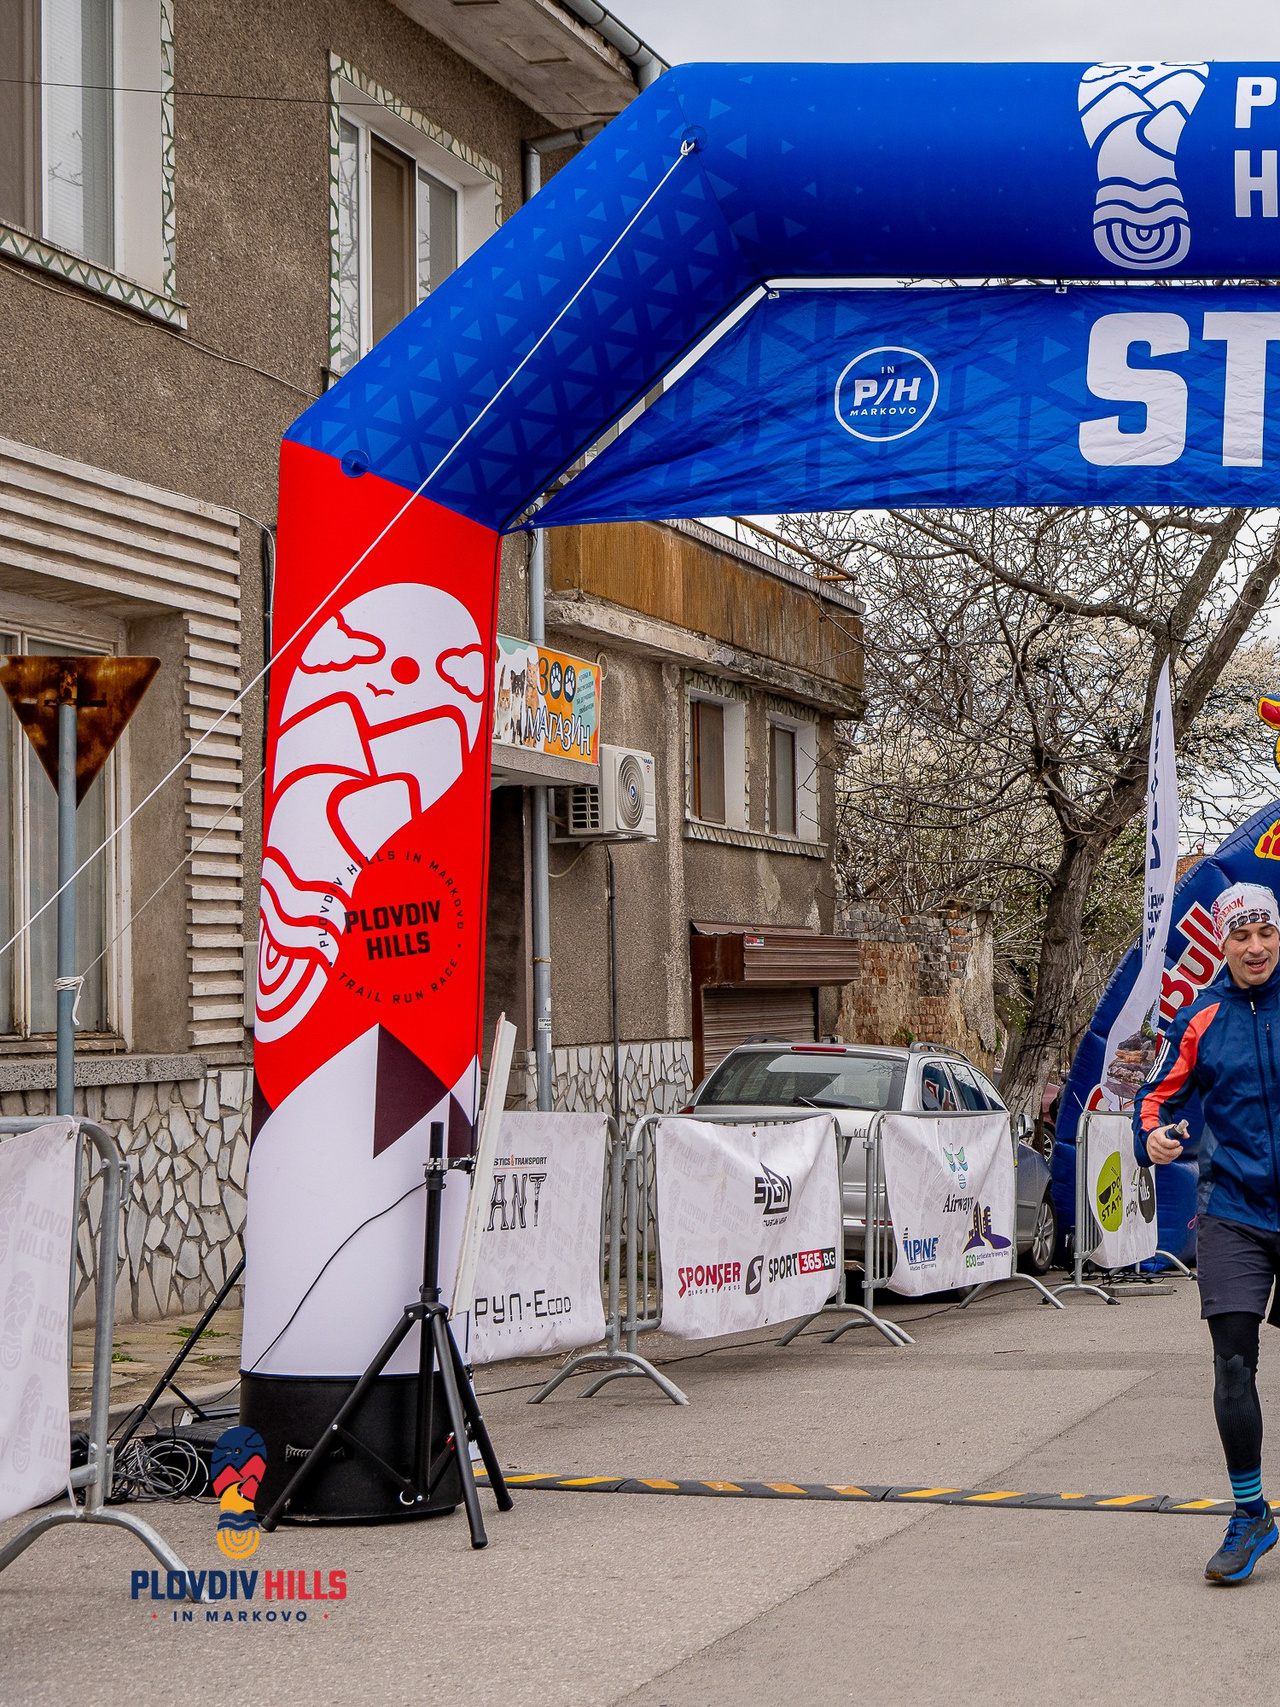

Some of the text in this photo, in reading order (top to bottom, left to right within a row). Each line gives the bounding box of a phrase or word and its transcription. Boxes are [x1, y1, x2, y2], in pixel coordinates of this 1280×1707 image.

[881, 366, 895, 374] IN
[853, 377, 922, 407] P/H
[849, 407, 917, 416] MARKOVO
[526, 705, 591, 756] МАГАЗИН
[318, 850, 464, 949] PLOVDIV HILLS IN MARKOVO
[344, 899, 441, 934] PLOVDIV
[366, 931, 431, 961] HILLS
[338, 958, 459, 1005] TRAIL RUN RACE
[493, 1157, 511, 1166] STICS
[515, 1156, 548, 1165] TRANSPORT
[966, 1254, 977, 1269] ECO
[678, 1262, 741, 1298] SPONSER
